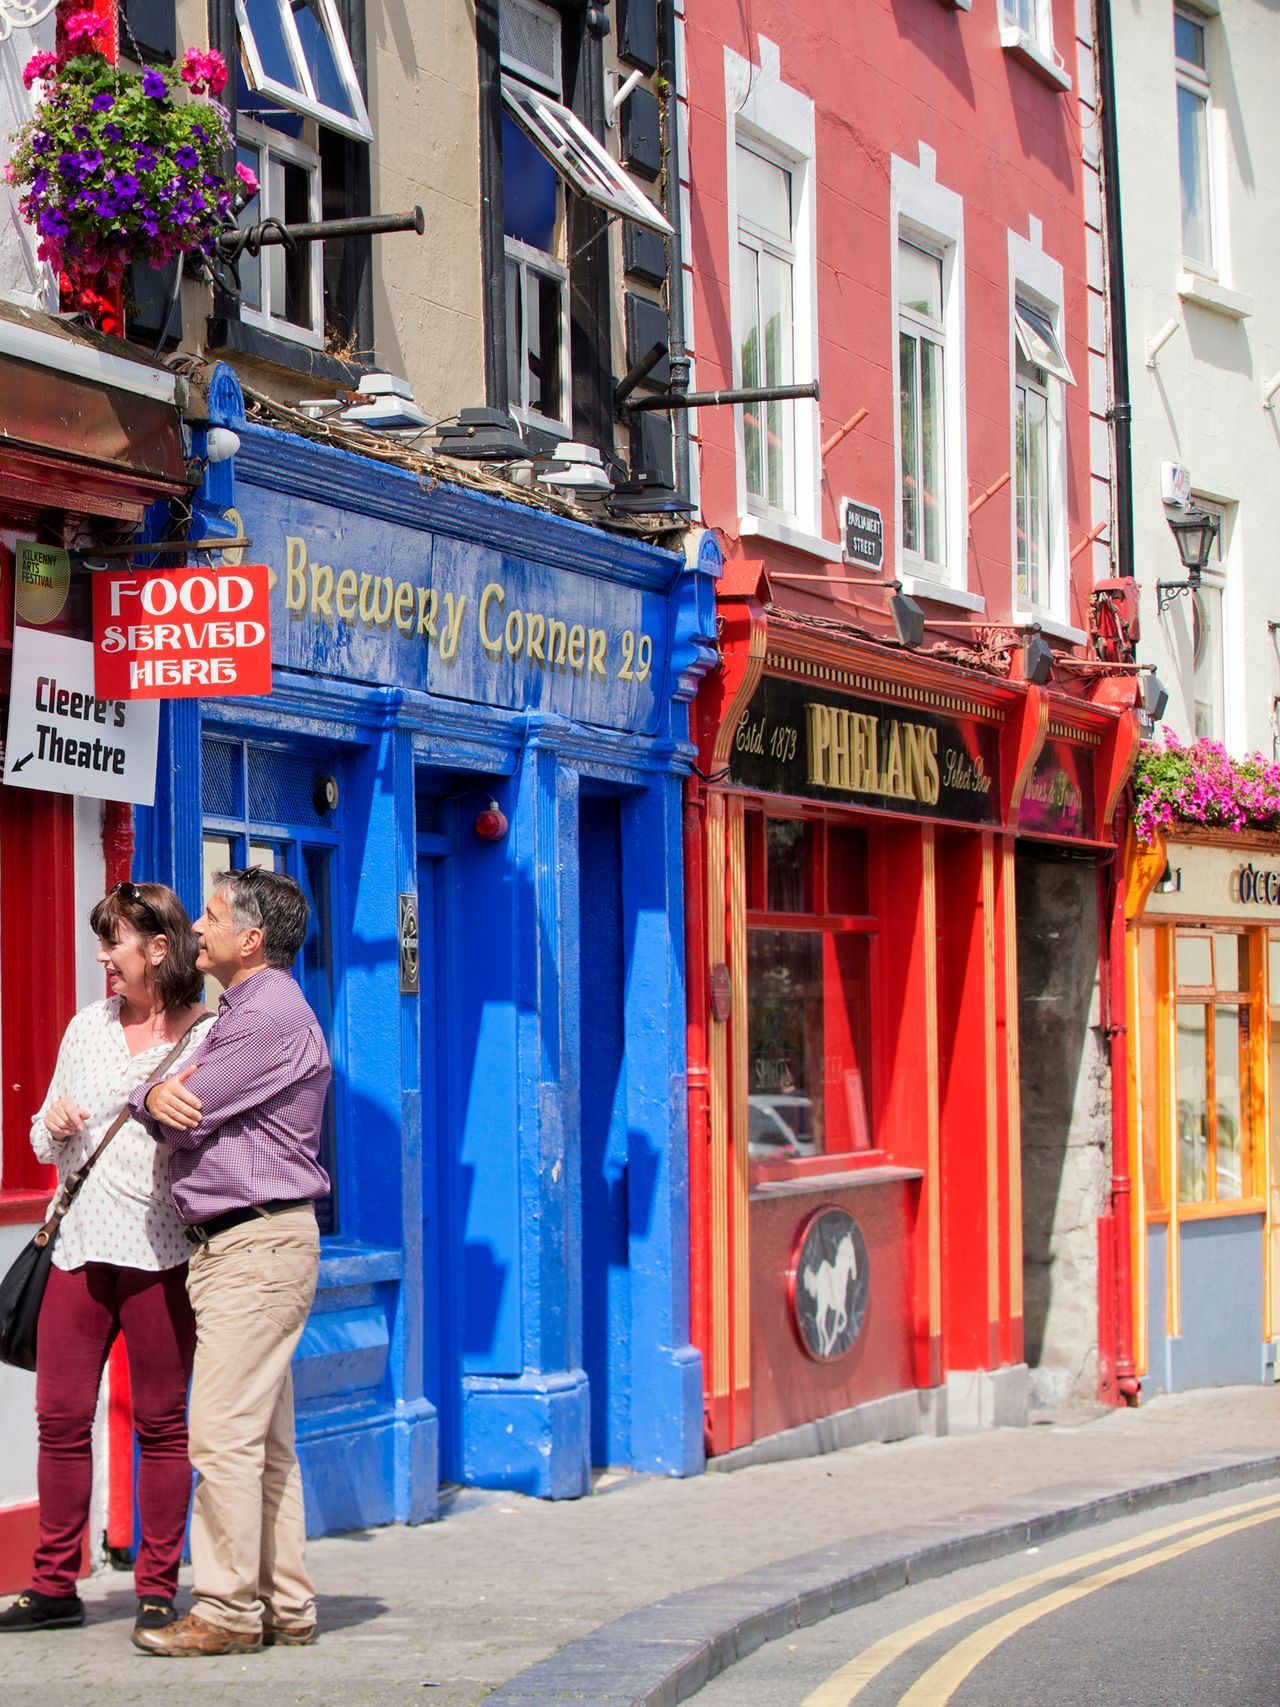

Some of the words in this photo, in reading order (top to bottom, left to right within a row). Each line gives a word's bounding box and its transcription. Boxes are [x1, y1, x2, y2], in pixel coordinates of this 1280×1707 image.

[847, 510, 880, 535] PARLIAMENT
[22, 548, 57, 567] KILKENNY
[852, 537, 876, 556] STREET
[22, 559, 40, 574] ARTS
[22, 570, 54, 589] FESTIVAL
[110, 576, 254, 616] FOOD
[101, 621, 266, 653] SERVED
[620, 630, 653, 683] 29
[130, 657, 237, 690] HERE
[35, 676, 126, 728] Cleere's
[36, 724, 126, 775] Theatre
[736, 709, 766, 756] Estd.
[770, 725, 797, 763] 1873
[803, 702, 940, 806] PHELANS
[943, 748, 972, 790] Select
[972, 756, 992, 793] Bar
